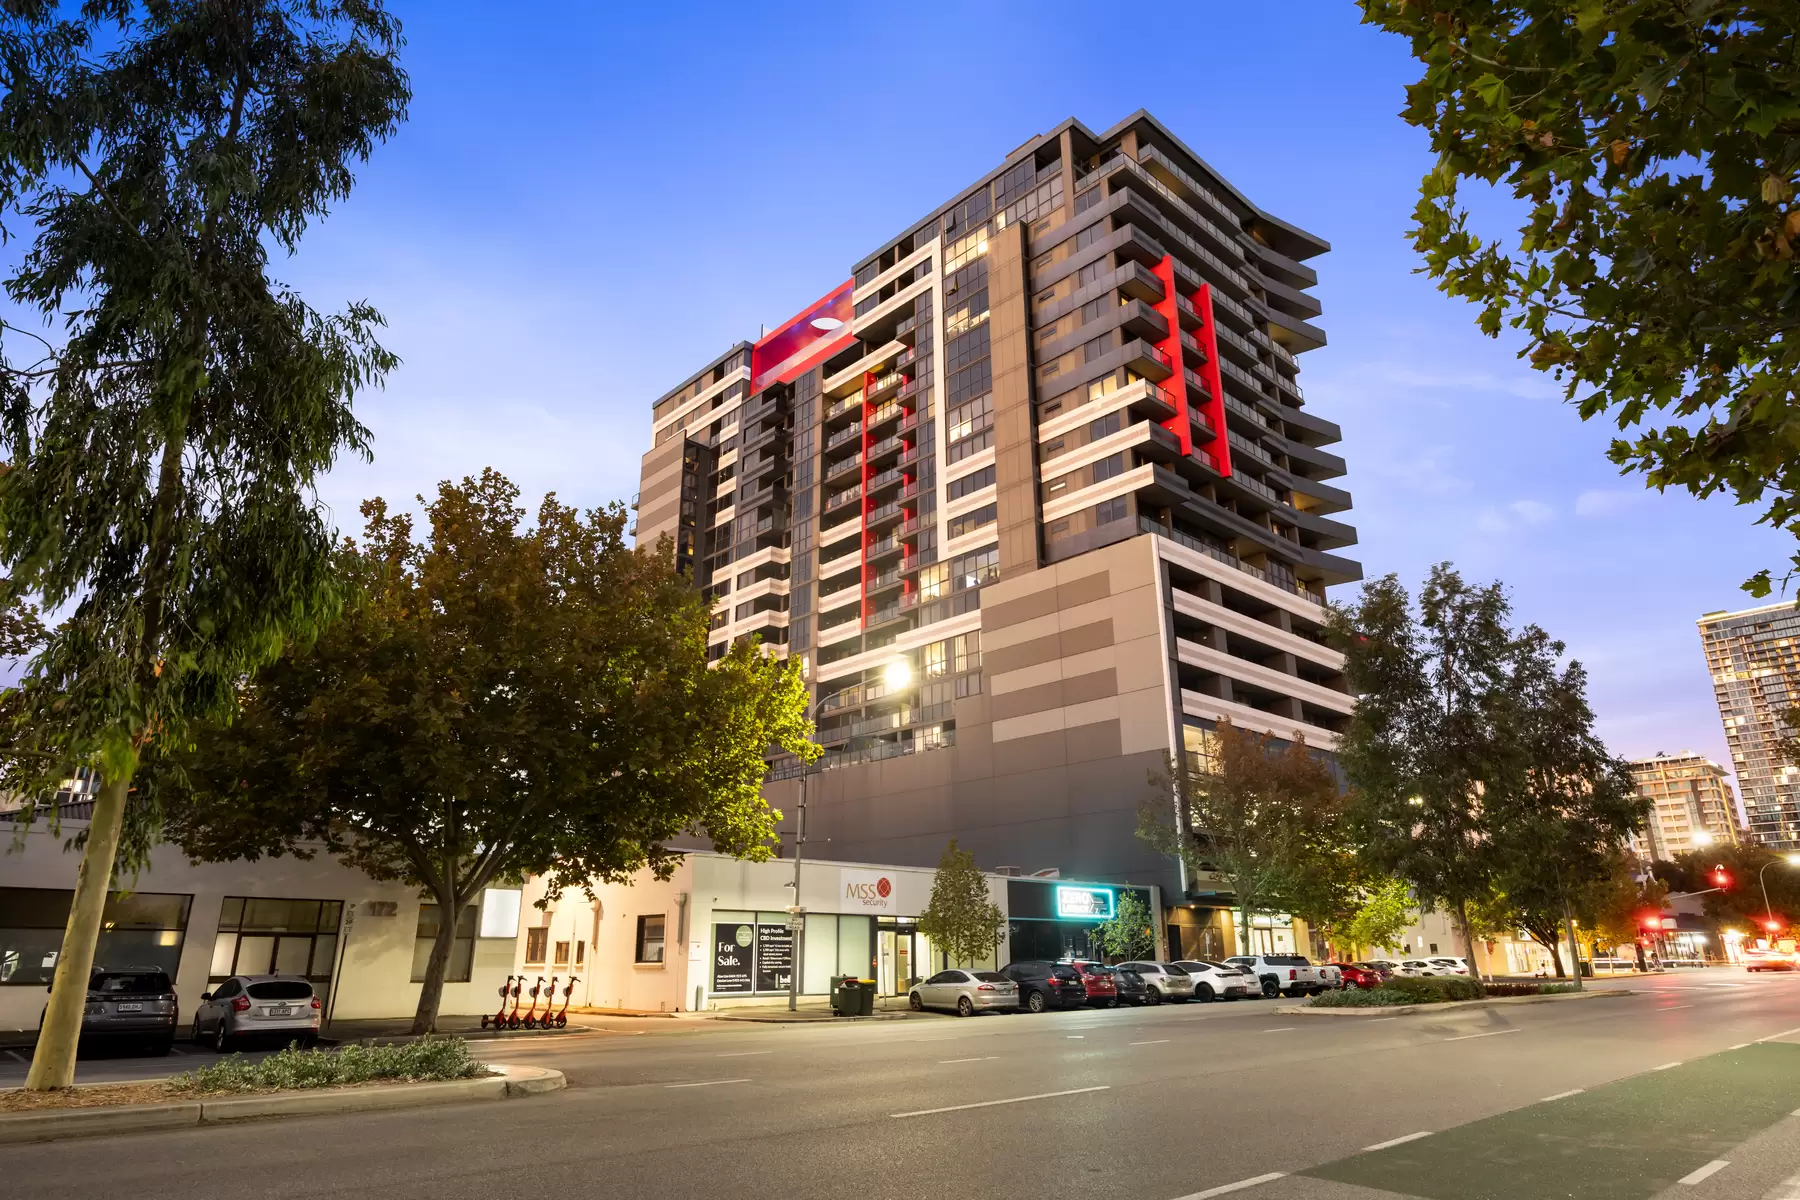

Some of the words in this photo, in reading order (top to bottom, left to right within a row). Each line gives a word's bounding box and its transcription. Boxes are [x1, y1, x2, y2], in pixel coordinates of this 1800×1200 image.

[846, 883, 876, 899] MSS
[862, 899, 888, 908] security
[718, 941, 736, 952] For
[717, 955, 740, 966] Sale.
